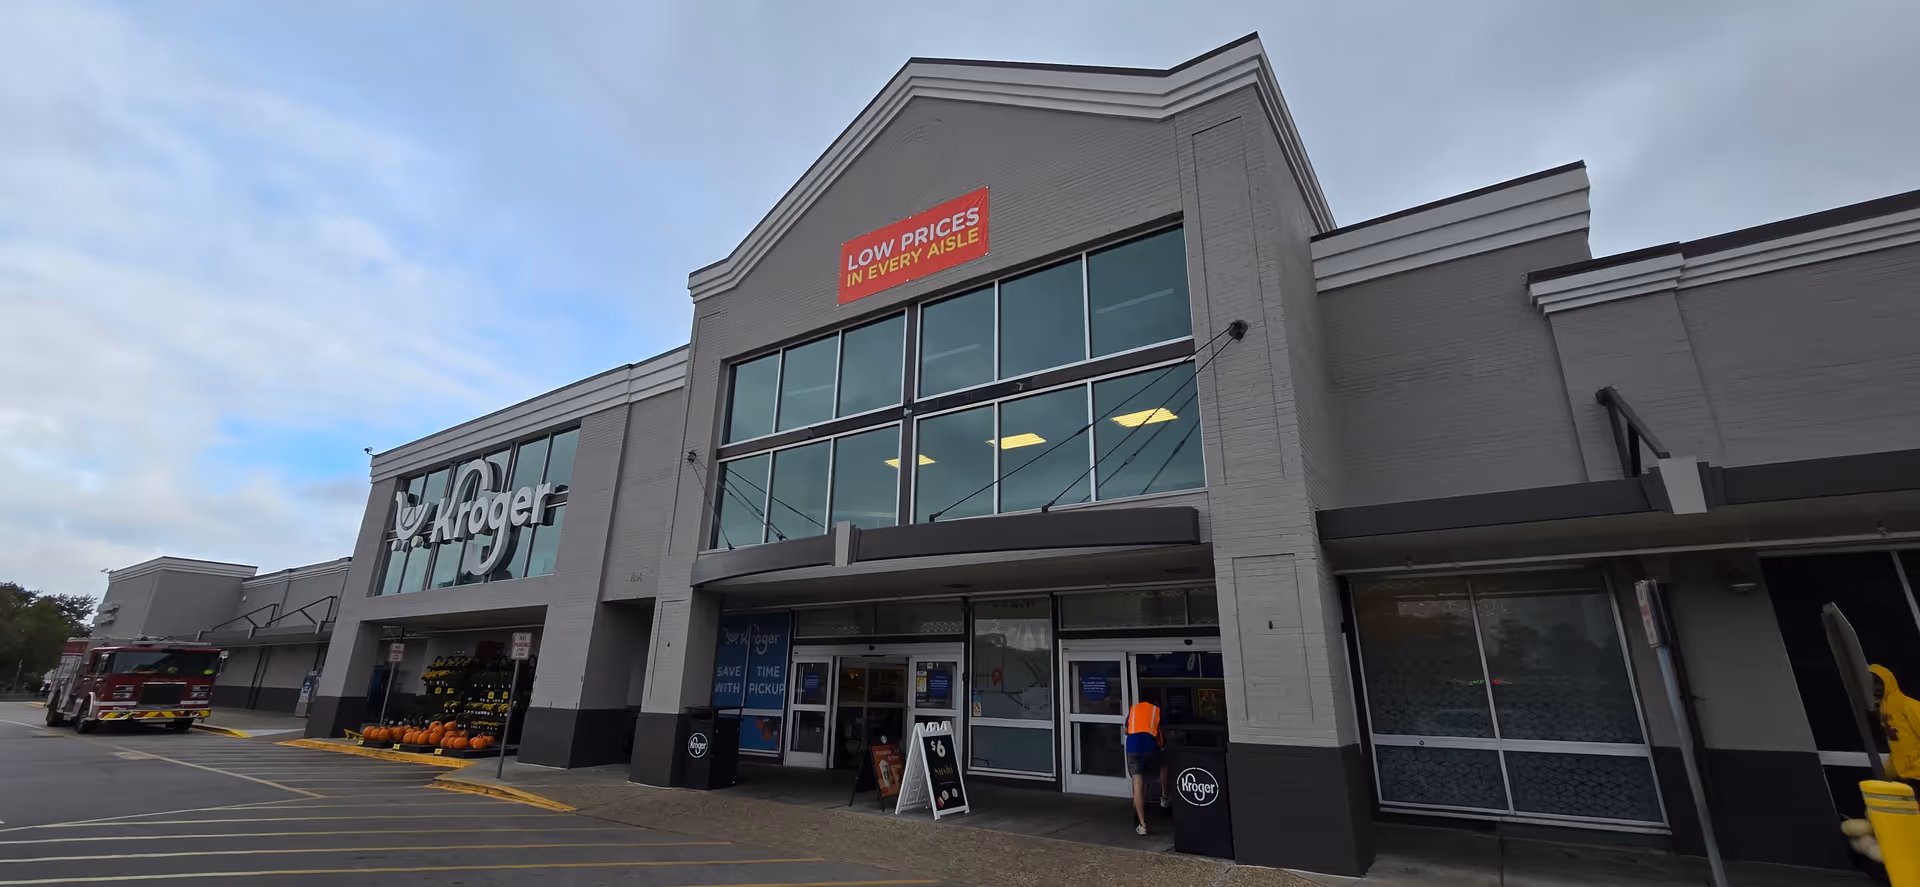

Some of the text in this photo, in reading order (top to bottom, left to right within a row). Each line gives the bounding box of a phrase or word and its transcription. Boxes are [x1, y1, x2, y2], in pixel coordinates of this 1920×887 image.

[848, 207, 979, 271] LOW PRICES
[847, 227, 979, 287] IN EVERY AISLE
[429, 458, 554, 576] Kroger
[716, 665, 781, 677] SAVE TIME
[715, 682, 785, 695] WITH PICKUP
[689, 736, 707, 755] Kroger
[930, 739, 946, 758] $6
[1181, 773, 1215, 801] Kroger
